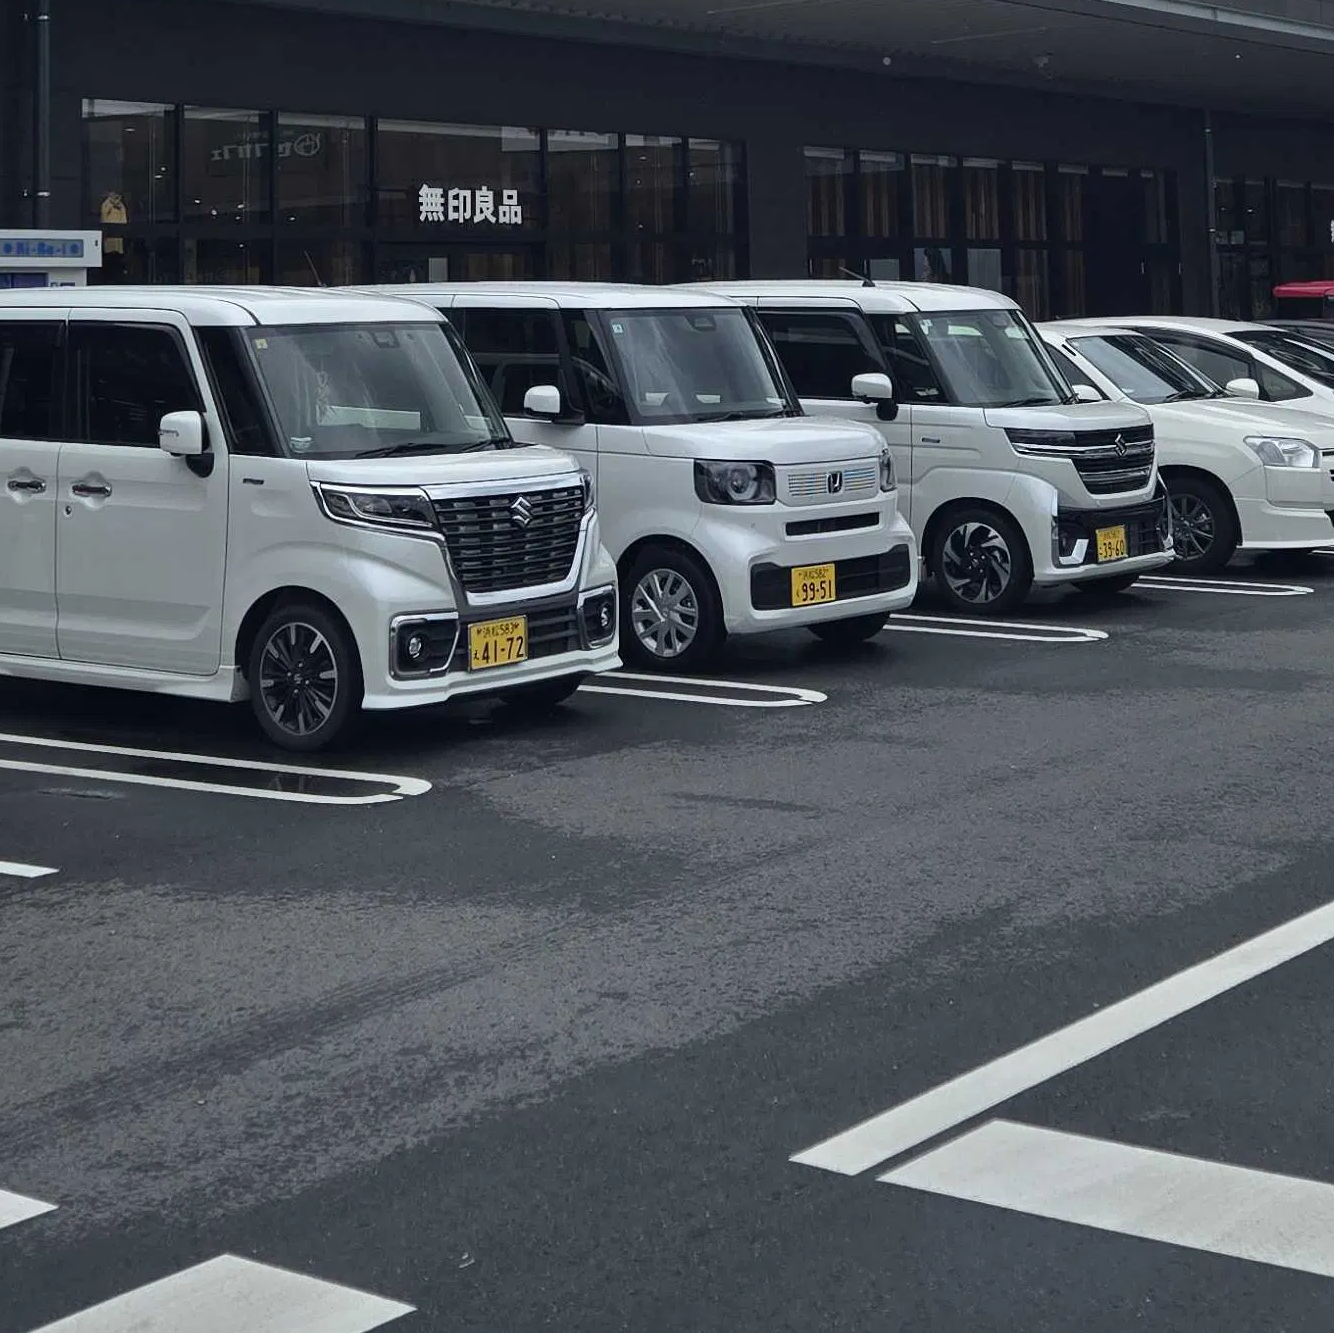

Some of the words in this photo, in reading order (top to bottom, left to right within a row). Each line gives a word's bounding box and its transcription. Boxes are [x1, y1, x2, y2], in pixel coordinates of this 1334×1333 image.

[418, 183, 523, 225] 無印良品
[802, 578, 832, 602] 99-51
[482, 635, 524, 664] 41-72
